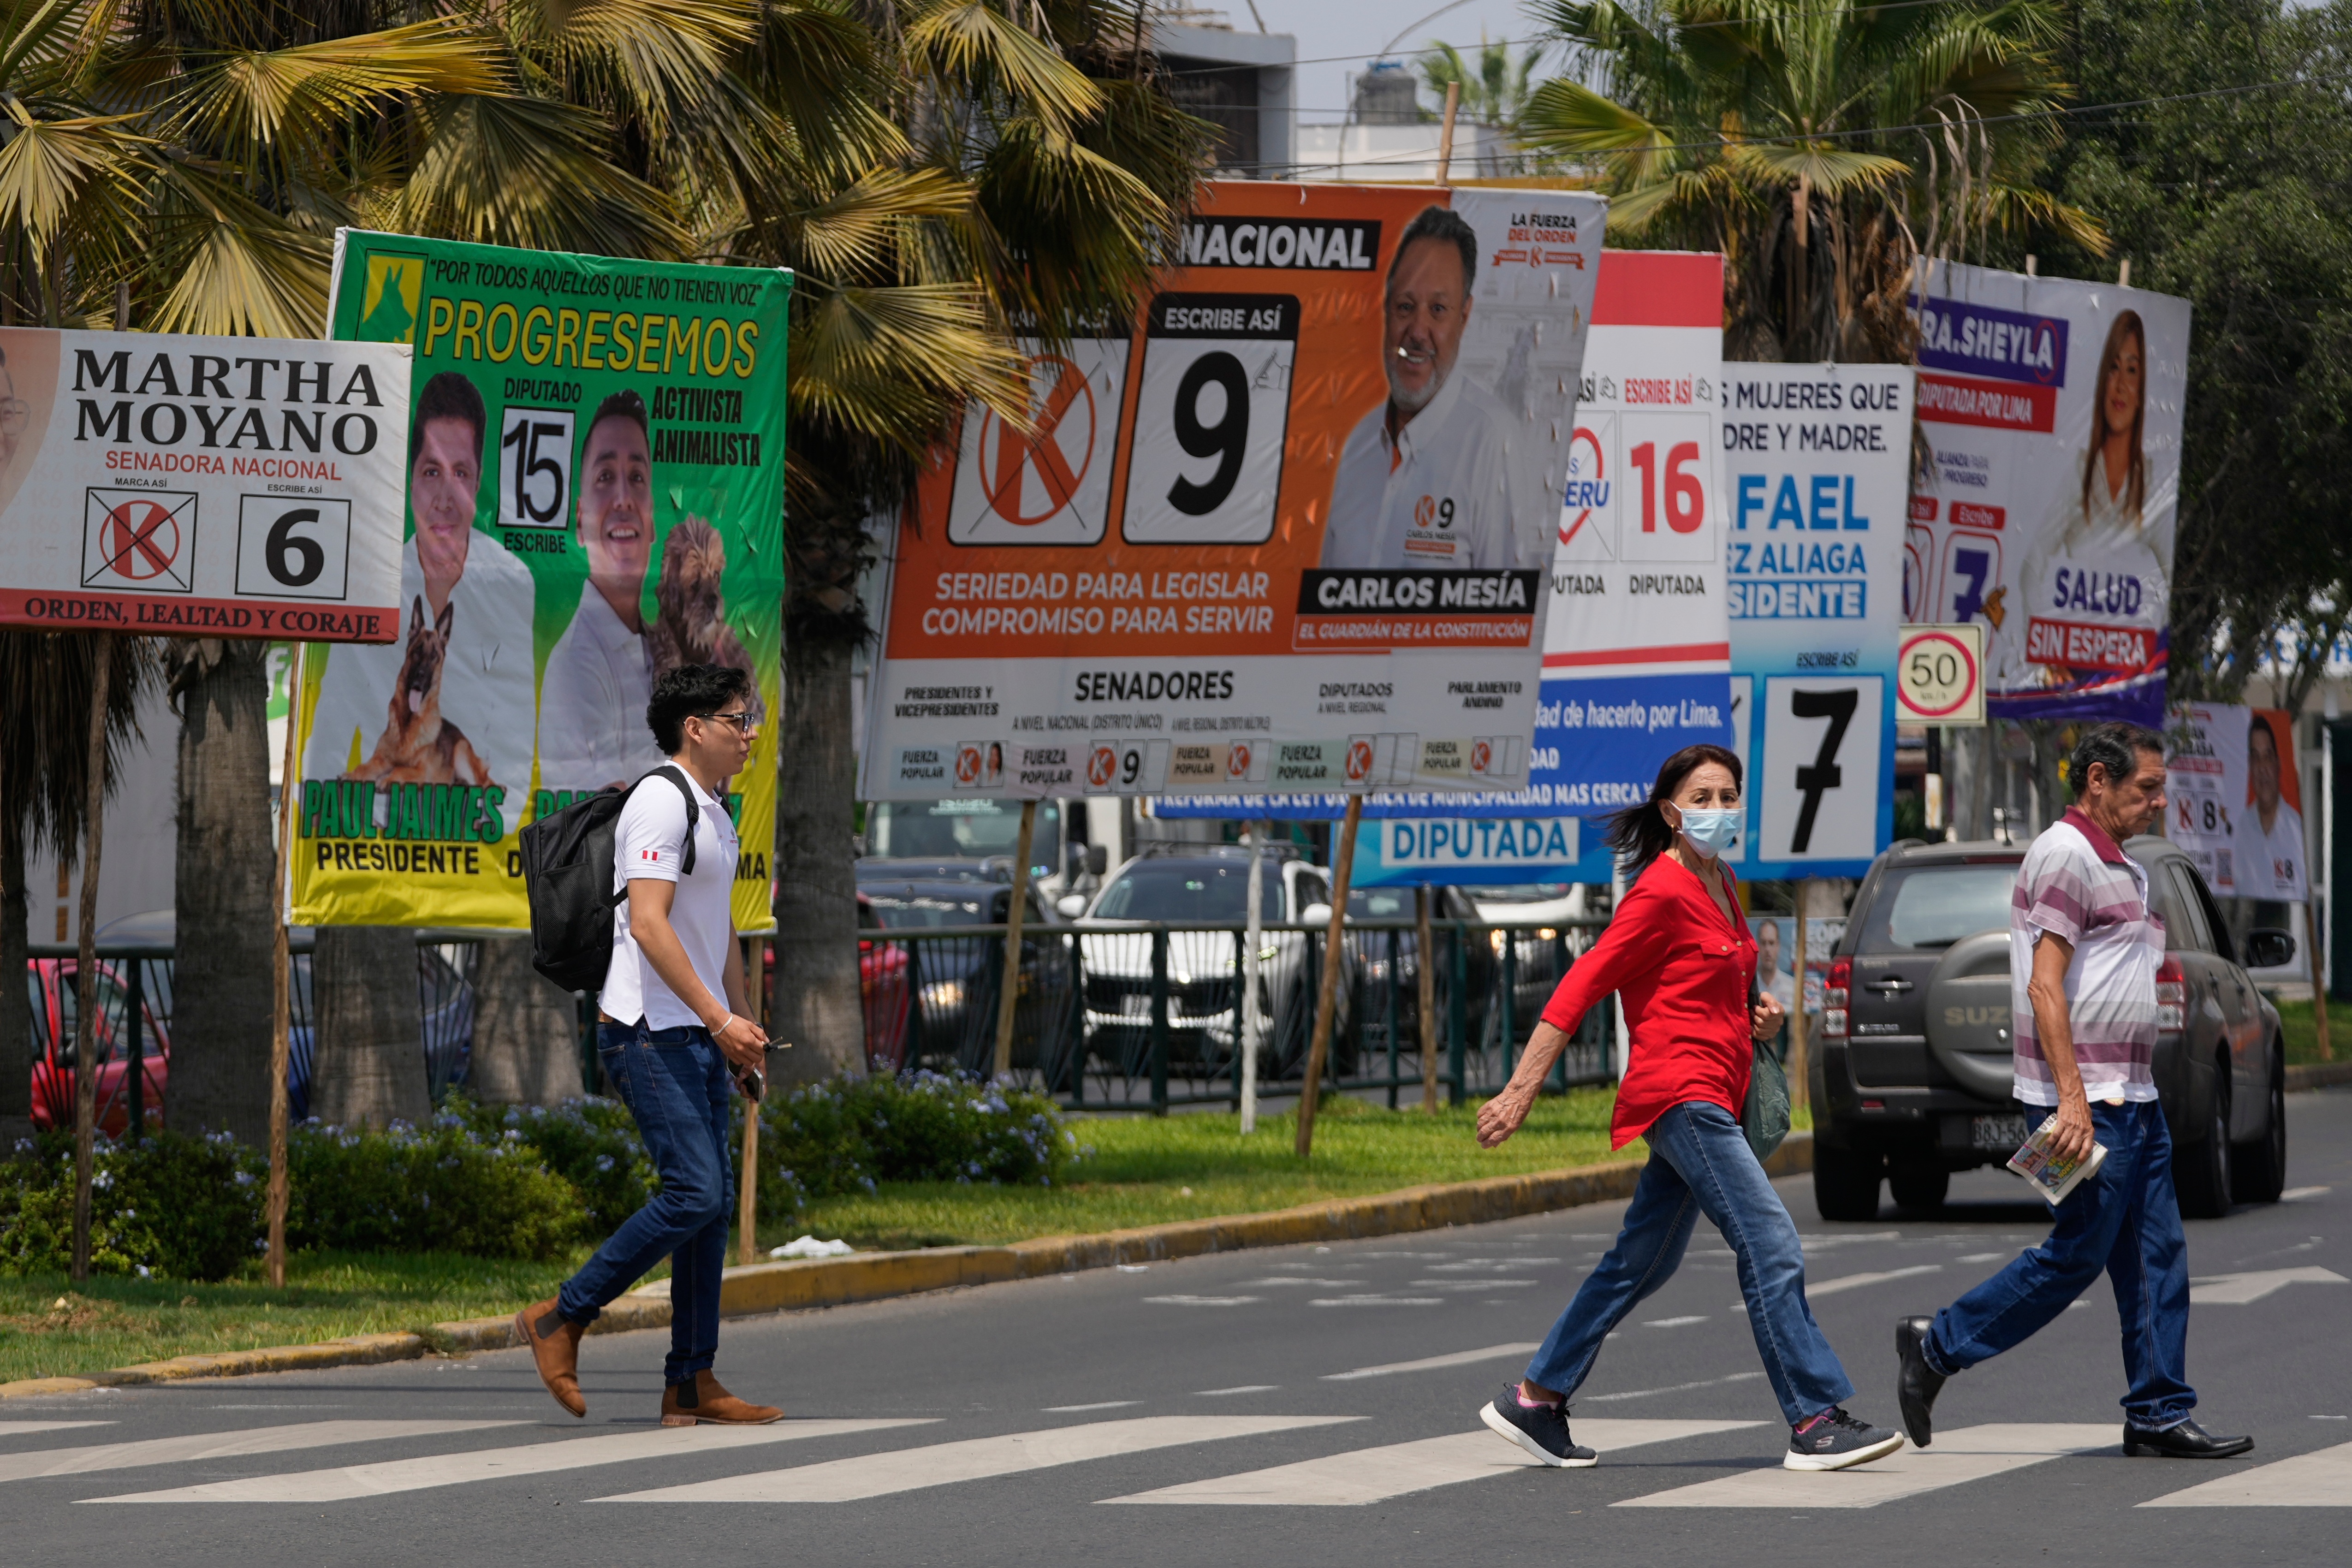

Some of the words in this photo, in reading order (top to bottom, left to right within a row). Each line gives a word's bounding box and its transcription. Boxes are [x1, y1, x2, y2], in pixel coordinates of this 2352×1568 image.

[1508, 228, 1531, 241] DEL
[1534, 229, 1576, 243] ORDEN
[1511, 213, 1526, 226] LA
[1530, 214, 1576, 228] FUERZA
[1178, 223, 1372, 268] NACIONAL
[475, 263, 526, 290] TODOS
[532, 267, 610, 296] AQUELLOS
[613, 272, 644, 301] QUE
[648, 277, 669, 302] NO
[675, 279, 727, 304] TIENEN
[1164, 307, 1246, 331] ESCRIBE
[1248, 303, 1283, 332] ASÍ
[423, 296, 760, 379] PROGRESEMOS
[71, 349, 384, 408] MARTHA
[505, 377, 582, 404] DIPUTADO
[1624, 377, 1671, 404] ESCRIBE
[1674, 373, 1692, 405] ASÍ
[653, 385, 742, 424] ACTIVISTA
[1736, 381, 1841, 410] MUJERES
[1850, 383, 1899, 412] QUE
[1918, 381, 1977, 415] DIPUTADA
[1977, 391, 2002, 419] POR
[2002, 394, 2032, 424] LIMA
[74, 399, 378, 455] MOYANO
[1167, 350, 1249, 516] 9
[1723, 422, 1768, 451] DRE
[1776, 423, 1792, 450] Y
[1799, 423, 1887, 452] MADRE.
[653, 428, 761, 467] ANIMALISTA
[105, 450, 226, 475] SENADORA
[232, 457, 342, 481] NACIONAL
[503, 419, 565, 524] 15
[114, 477, 150, 488] MARCA
[151, 477, 167, 488] ASÍ
[267, 484, 306, 493] ESCRIBE
[307, 483, 322, 494] ASÍ
[1631, 440, 1704, 534] 16
[1437, 497, 1455, 528] 9
[1729, 474, 1869, 530] FAEL
[1959, 505, 1995, 526] Escribe
[265, 508, 325, 586] 6
[505, 531, 566, 553] ESCRIBE
[1757, 542, 1867, 574] ALIAGA
[936, 572, 1068, 600] SERIEDAD
[1075, 572, 1144, 600] PARA
[1151, 570, 1270, 599] LEGISLAR
[1318, 576, 1433, 608] CARLOS
[1440, 570, 1526, 608] MESÍA
[1629, 574, 1705, 595] DIPUTADA
[1728, 582, 1861, 617] SIDENTE
[1954, 546, 1989, 622] 7
[2054, 566, 2141, 615] SALUD
[25, 598, 129, 625] ORDEN,
[136, 603, 252, 628] LEALTAD
[256, 609, 275, 630] Y
[280, 610, 380, 638] CORAJE
[922, 606, 1105, 636] COMPROMISO
[1110, 606, 1179, 634] PARA
[1184, 605, 1274, 633] SERVIR
[1298, 623, 1317, 639] EL
[1319, 618, 1390, 639] GUARDIÁN
[1392, 623, 1409, 639] DE
[1412, 623, 1431, 638] LA
[1433, 618, 1529, 639] CONSTITUCIÓN
[1796, 652, 1839, 667] ESCRIBE
[1840, 648, 1860, 666] ASÍ
[2029, 622, 2064, 662] SIN
[2067, 626, 2147, 667] ESPERA
[1910, 653, 1956, 687] 50
[904, 686, 982, 700] PRESIDENTES
[985, 686, 993, 699] Y
[1074, 671, 1234, 702] SENADORES
[1318, 682, 1394, 698] DIPUTADOS
[1447, 681, 1523, 695] PARLAMENTO
[1461, 695, 1504, 708] ANDINO
[895, 702, 999, 718] VICEPRESIDENTES
[1047, 715, 1088, 731] NACIONAL
[1563, 699, 1584, 728] de
[1586, 699, 1646, 728] hacerlo
[1648, 705, 1678, 734] por
[1679, 699, 1723, 728] Lima.
[902, 749, 939, 764] FUERZA
[1022, 748, 1067, 765] FUERZA
[1176, 746, 1210, 760] FUERZA
[1280, 744, 1322, 761] FUERZA
[1423, 757, 1461, 769] POPULAR
[1425, 741, 1457, 754] FUERZA
[900, 766, 944, 779] POPULAR
[1019, 768, 1073, 784] POPULAR
[1121, 748, 1140, 784] 9
[1174, 762, 1215, 774] POPULAR
[1277, 765, 1328, 780] POPULAR
[1790, 687, 1858, 853] 7
[1555, 783, 1590, 806] MAS
[1592, 782, 1641, 805] CERCA
[301, 780, 376, 838] PAUL
[383, 781, 505, 843] JAIMES
[2203, 799, 2216, 831] 8
[1392, 819, 1568, 859] DIPUTADA
[317, 841, 480, 874] PRESIDENTE
[1944, 1006, 2013, 1027] SUZ
